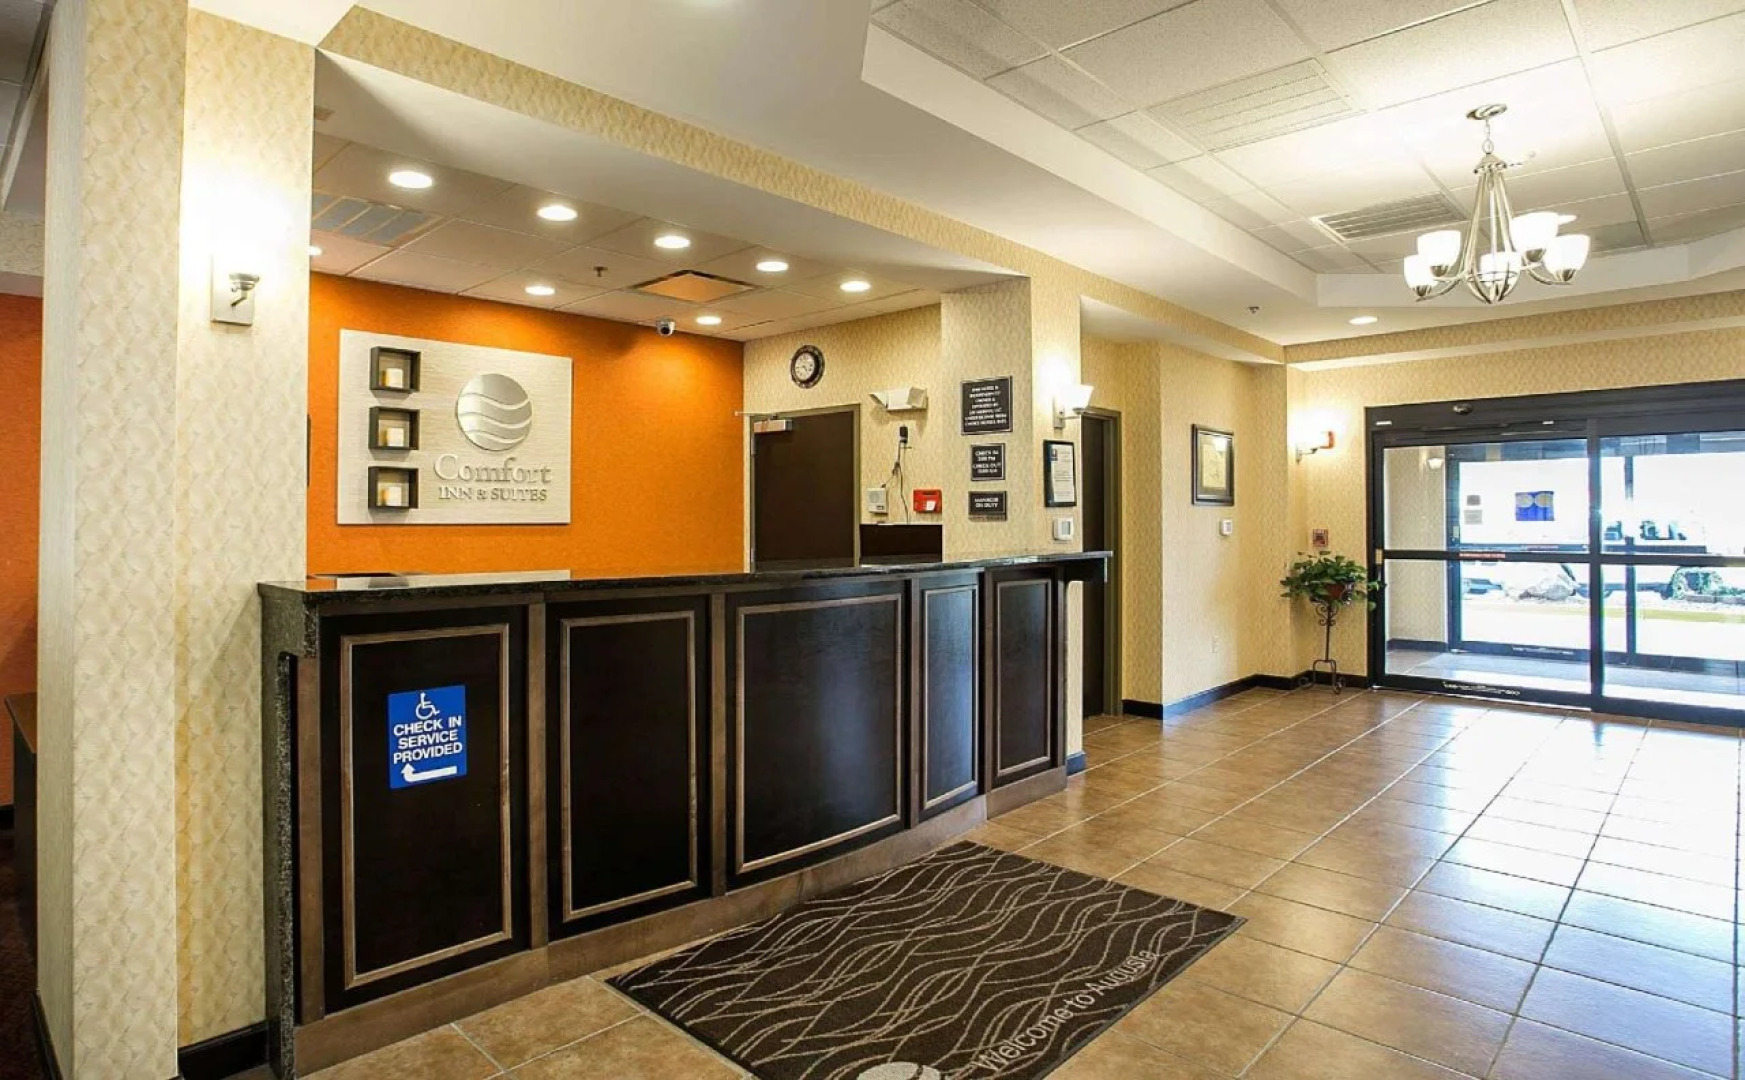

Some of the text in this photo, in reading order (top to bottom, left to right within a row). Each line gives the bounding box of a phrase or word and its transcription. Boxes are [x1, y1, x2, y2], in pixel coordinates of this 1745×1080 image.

[433, 454, 552, 484] Comfort
[438, 486, 548, 502] INN & SUITES
[393, 715, 462, 736] CHECK IN
[398, 729, 458, 750] SERVICE
[393, 742, 463, 765] PROVIDED
[972, 948, 1158, 1072] Welcome to Augusta
